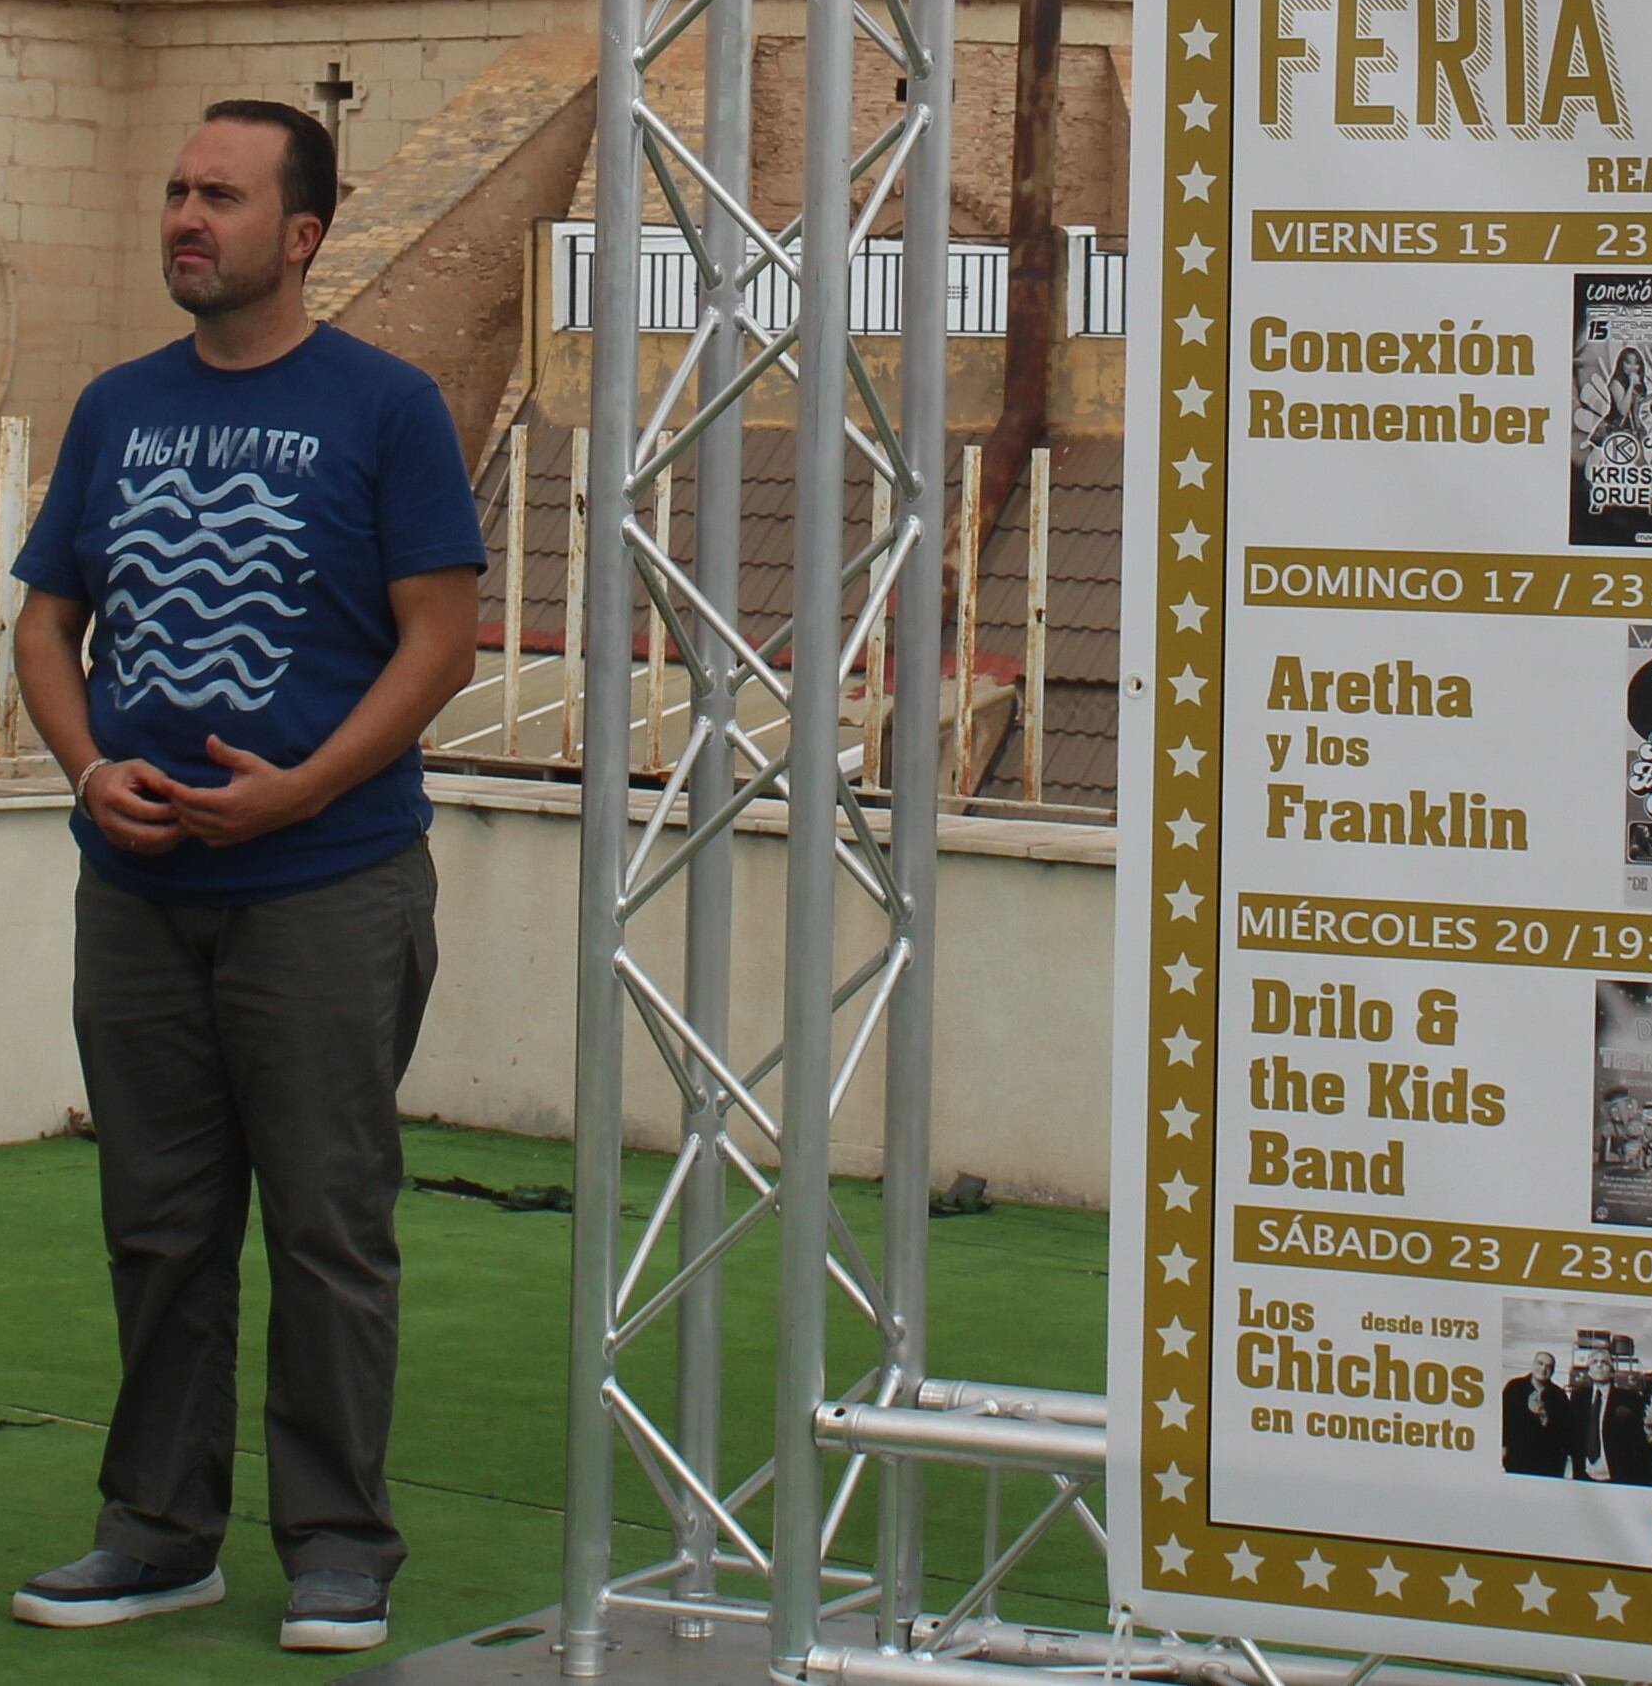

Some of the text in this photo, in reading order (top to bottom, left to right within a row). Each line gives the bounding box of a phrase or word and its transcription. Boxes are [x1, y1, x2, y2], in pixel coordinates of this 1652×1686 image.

[1265, 221, 1439, 256] VIERNES
[1458, 223, 1508, 257] 15
[1543, 224, 1562, 262] /
[1248, 316, 1535, 377] Conexión
[1587, 319, 1610, 341] 15
[1247, 389, 1550, 445] Remember
[122, 425, 321, 477] HIGH WATER
[1591, 466, 1652, 485] KRISS
[1592, 487, 1651, 505] ORUE
[1248, 562, 1465, 602] DOMINGO
[1483, 570, 1535, 605] 17
[1553, 573, 1572, 611] /
[1266, 654, 1474, 719] Aretha
[1265, 724, 1371, 773] y los
[1265, 782, 1530, 851] Franklin
[1240, 901, 1478, 952] MIÉRCOLES
[1494, 919, 1549, 954] 20
[1562, 923, 1581, 961] /
[1251, 977, 1459, 1047] Drilo &
[1249, 1055, 1507, 1127] the Kids
[1248, 1129, 1406, 1197] Band
[1256, 1215, 1434, 1265] SÁBADO
[1449, 1234, 1501, 1272] 23
[1521, 1242, 1541, 1280] /
[1237, 1287, 1316, 1333] Los
[1360, 1311, 1481, 1341] desde 1973
[1235, 1331, 1486, 1410] Chichos
[1250, 1406, 1476, 1453] en concierto
